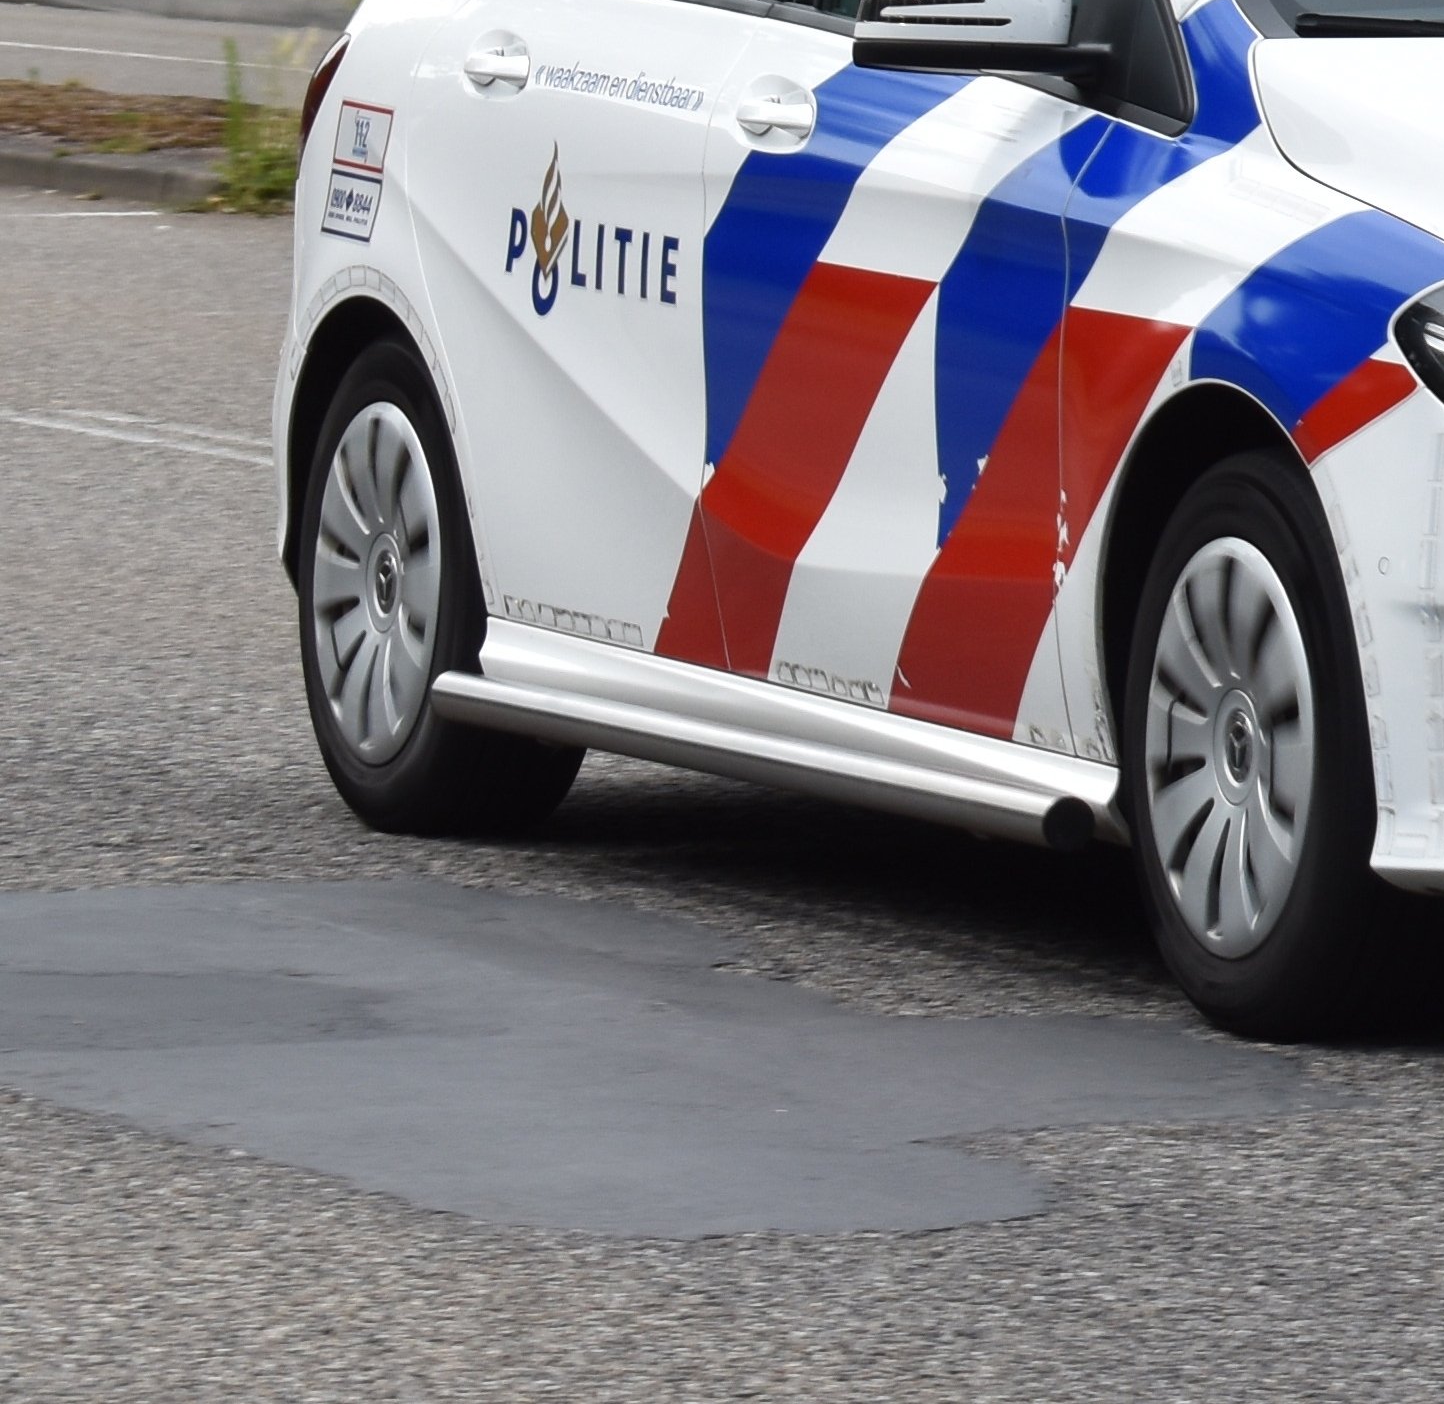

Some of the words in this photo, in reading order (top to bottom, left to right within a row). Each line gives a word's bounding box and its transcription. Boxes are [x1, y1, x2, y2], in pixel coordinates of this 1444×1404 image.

[544, 60, 610, 95] waakzaam
[608, 77, 628, 98] en
[626, 70, 697, 109] dienstbaar
[504, 207, 681, 317] POLITIE
